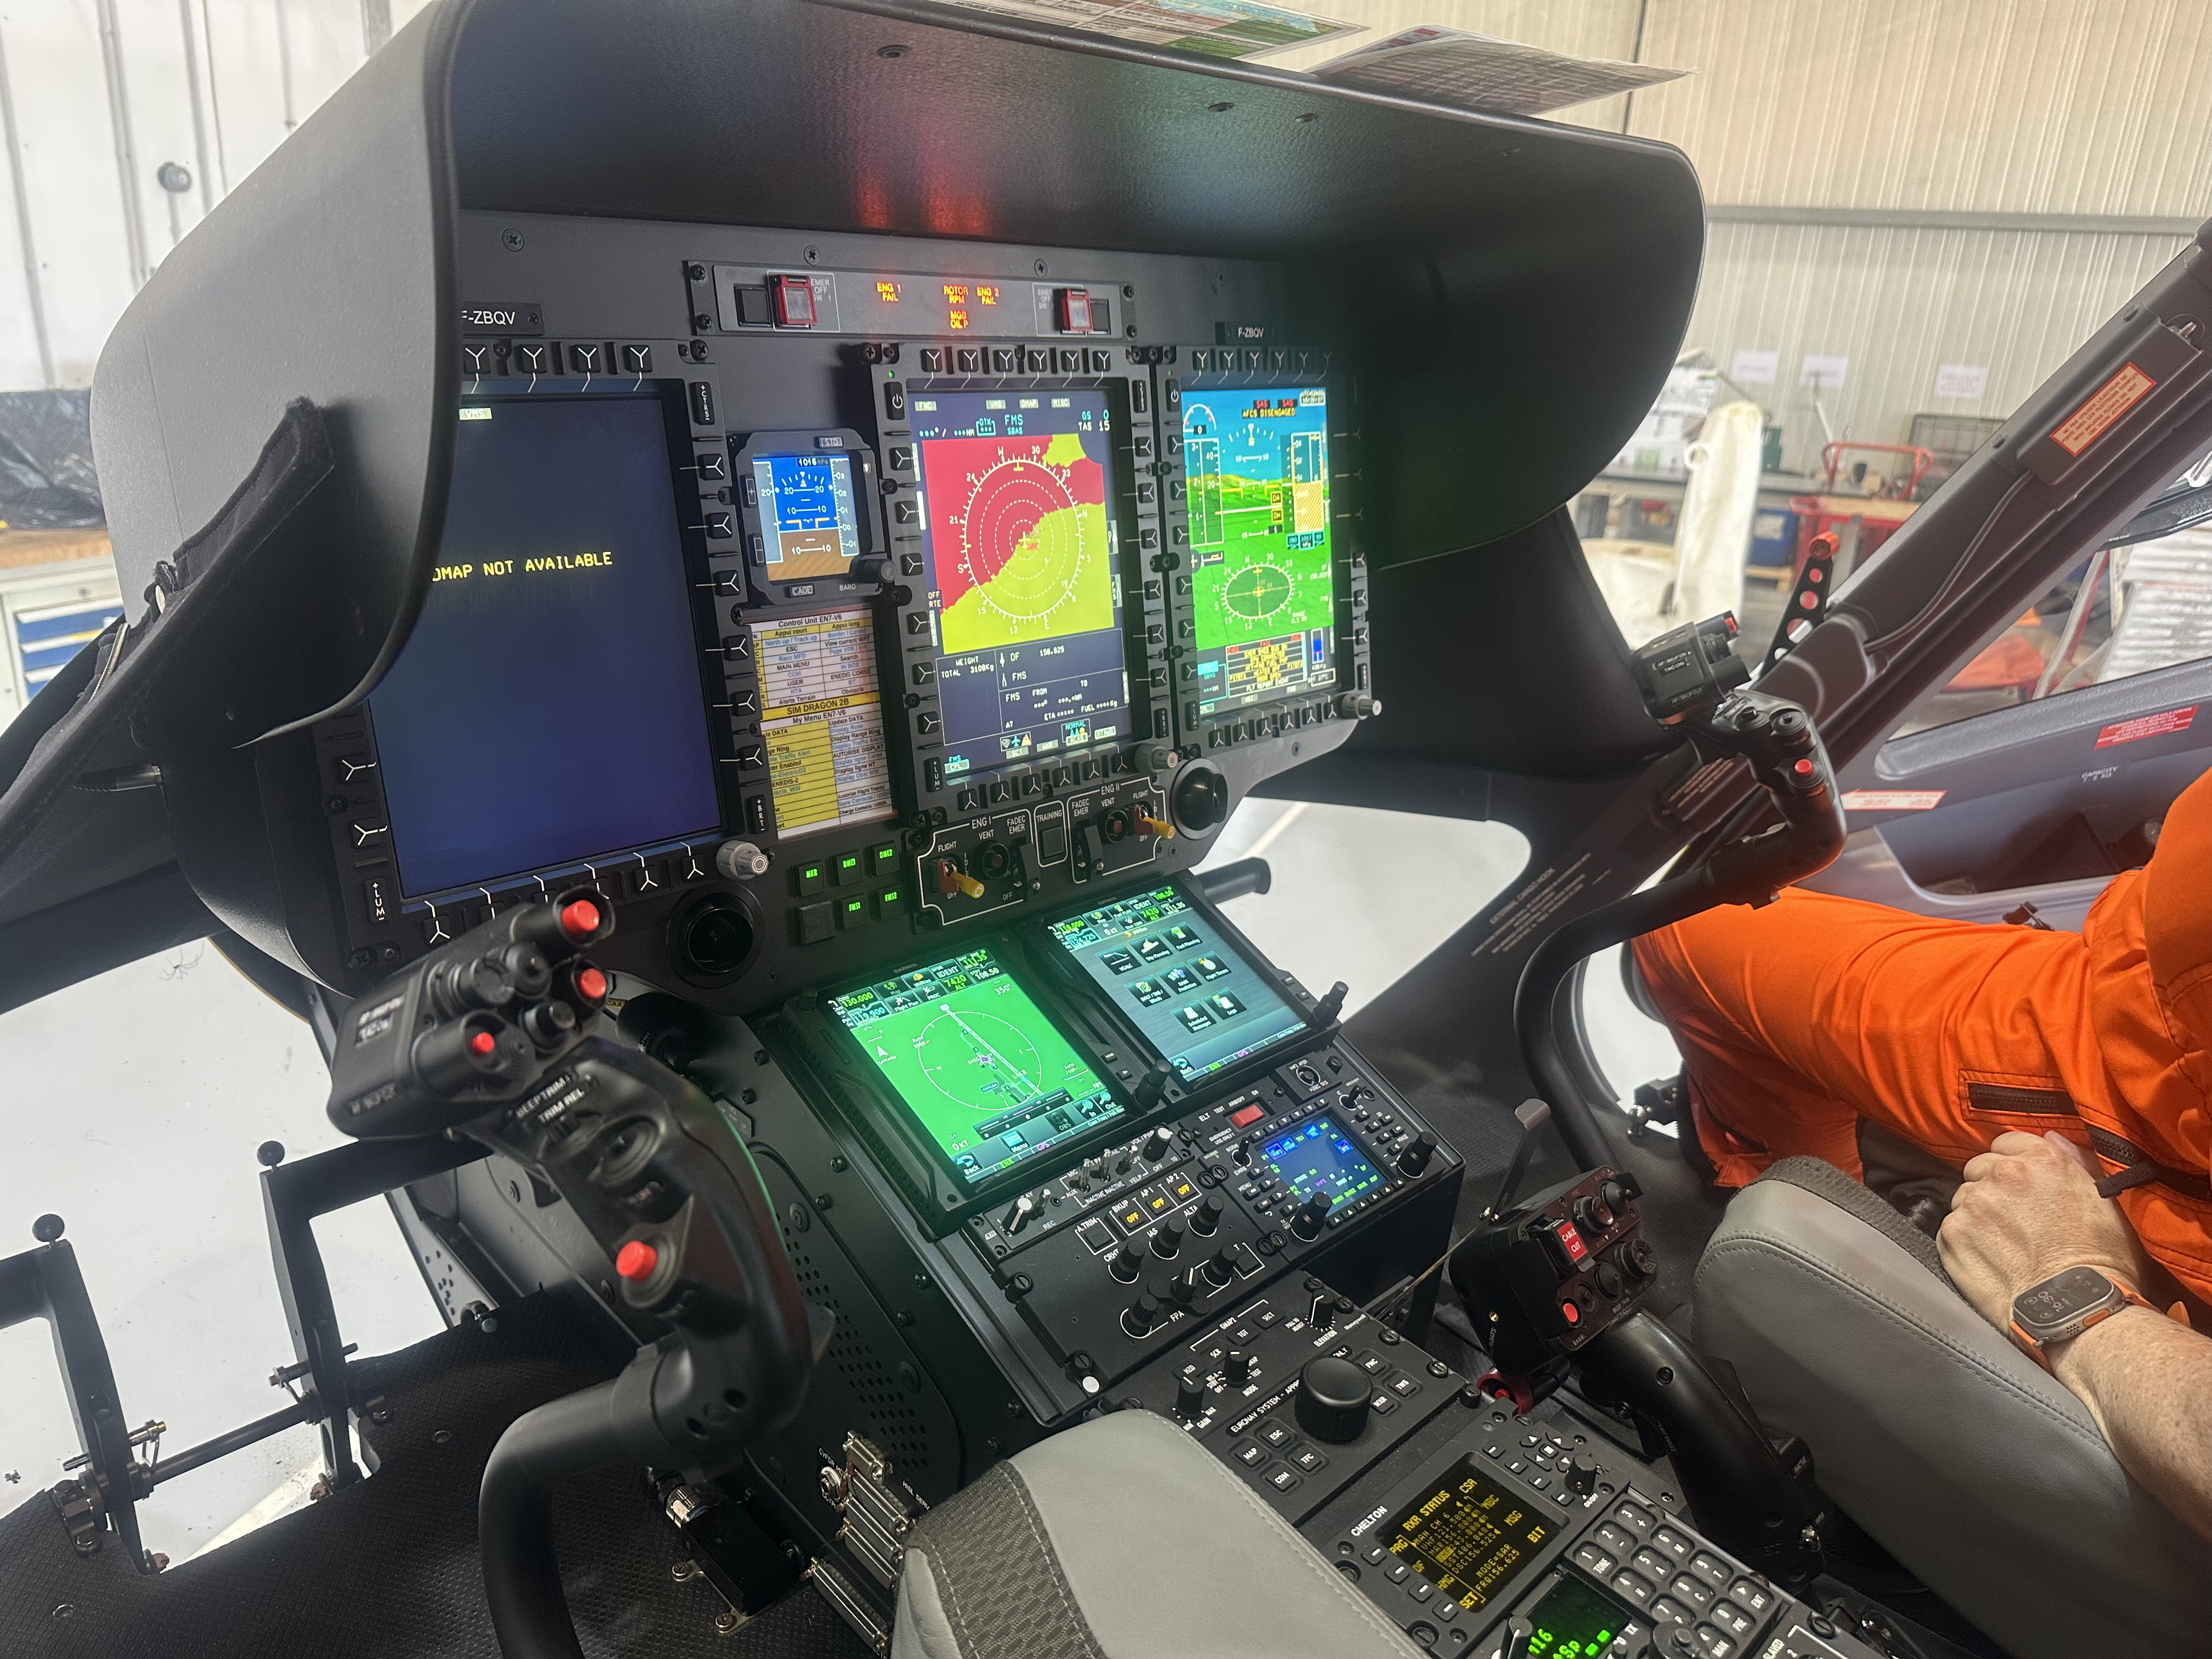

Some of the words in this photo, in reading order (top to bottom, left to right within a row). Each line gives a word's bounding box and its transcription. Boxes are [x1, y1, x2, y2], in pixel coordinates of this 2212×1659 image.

[877, 282, 893, 292] ENG
[897, 284, 901, 293] 1
[944, 285, 968, 295] ROTOR
[977, 287, 992, 296] ENG
[994, 288, 1000, 297] 2
[882, 292, 898, 302] FAIL
[949, 295, 965, 303] RPM
[981, 296, 996, 305] FAIL
[950, 311, 967, 320] MGB
[950, 320, 962, 329] OIL
[1238, 328, 1264, 337] F-ZBQV
[1242, 409, 1258, 417] AFCS
[1005, 414, 1023, 425] FMS
[1079, 421, 1092, 431] TAS
[1099, 420, 1110, 431] 15
[483, 561, 513, 577] NOT
[525, 551, 612, 572] AVAILABLE
[792, 586, 812, 595] CAGE
[778, 619, 803, 627] Control
[956, 656, 978, 666] WEIGHT
[1011, 652, 1019, 661] DF
[941, 669, 961, 678] TOTAL
[1012, 672, 1026, 681] FMS
[1006, 693, 1020, 702] FMS
[803, 701, 837, 712] DRAGON
[1065, 721, 1086, 730] NORMAL
[1101, 787, 1114, 795] ENG
[1133, 790, 1148, 799] FLIGHT
[1072, 799, 1089, 809] FADEC
[1101, 798, 1115, 807] VENT
[1036, 809, 1063, 822] TRAINING
[1074, 807, 1088, 816] EMER
[972, 819, 987, 829] ENG
[1007, 815, 1026, 826] FADEC
[978, 830, 994, 839] VENT
[1009, 825, 1025, 834] EMER
[938, 841, 957, 852] FLIGHT
[879, 849, 893, 858] DME2
[843, 858, 855, 868] DME1
[885, 892, 897, 901] FMS2
[849, 902, 860, 911] FMS1
[1133, 900, 1152, 910] IDENT
[1141, 907, 1159, 918] 7420
[936, 966, 959, 978] IDENT
[974, 967, 1000, 980] 108.50
[944, 974, 967, 987] 7420
[842, 992, 873, 1007] 130.000
[1214, 1105, 1224, 1114] TEST
[1199, 1113, 1210, 1122] ELT
[1059, 1122, 1071, 1131] OBS
[1011, 1142, 1028, 1153] Menu
[1036, 1142, 1049, 1151] GPS
[1000, 1158, 1014, 1169] ENR
[963, 1165, 980, 1175] Back
[1067, 1169, 1078, 1178] MIC
[1129, 1174, 1143, 1184] YELP
[1166, 1176, 1175, 1184] AP
[1177, 1184, 1190, 1194] OFF
[1238, 1182, 1251, 1192] MENU
[1065, 1189, 1078, 1199] AUX
[1085, 1189, 1106, 1204] INACTIVE
[1106, 1181, 1125, 1195] INACTIVE
[1141, 1188, 1150, 1198] AP
[1112, 1200, 1128, 1212] BKUP
[1152, 1198, 1165, 1208] OFF
[1183, 1206, 1198, 1217] ALTA
[1126, 1212, 1139, 1223] OFF
[1043, 1220, 1056, 1229] REC
[1077, 1218, 1097, 1233] A.TRIM
[1147, 1228, 1158, 1238] IAS
[1562, 1228, 1577, 1242] CABLE
[1571, 1242, 1581, 1252] CUT
[1104, 1249, 1119, 1262] CRHT
[1170, 1310, 1184, 1322] FPA
[1262, 1311, 1274, 1322] SECT
[1219, 1317, 1236, 1330] GMAP2
[1344, 1314, 1366, 1330] Honeywell
[1238, 1328, 1249, 1338] TGT
[1489, 1327, 1497, 1348] FLOATS
[1313, 1330, 1337, 1347] ELEVATION
[1365, 1358, 1378, 1368] FNC
[1250, 1368, 1261, 1378] TEST
[1395, 1379, 1409, 1390] TWS
[1242, 1384, 1259, 1396] MODE
[1373, 1396, 1387, 1408] WXR
[1231, 1408, 1258, 1432] EURONAV
[1256, 1395, 1282, 1414] SYSTEM
[1269, 1429, 1283, 1440] ESC
[1243, 1448, 1257, 1459] MAP
[1300, 1453, 1314, 1463] TFC
[1274, 1471, 1289, 1483] COM
[1459, 1479, 1477, 1493] CSA
[1402, 1515, 1422, 1531] RXR
[1420, 1491, 1450, 1516] STATUS
[1351, 1505, 1387, 1536] CHELTON
[1504, 1510, 1522, 1526] MSG
[1527, 1527, 1545, 1543] BIT
[1389, 1539, 1408, 1555] PRG
[1476, 1543, 1512, 1577] MODE=SAR
[1475, 1549, 1519, 1591] FRQ156.625
[1593, 1558, 1611, 1574] TONE
[1436, 1574, 1454, 1590] HMG
[1459, 1593, 1478, 1609] SET
[1751, 1594, 1765, 1608] ENT
[1624, 1623, 1638, 1635] TX
[1732, 1617, 1748, 1632] PRE
[1711, 1641, 1729, 1657] MAN
